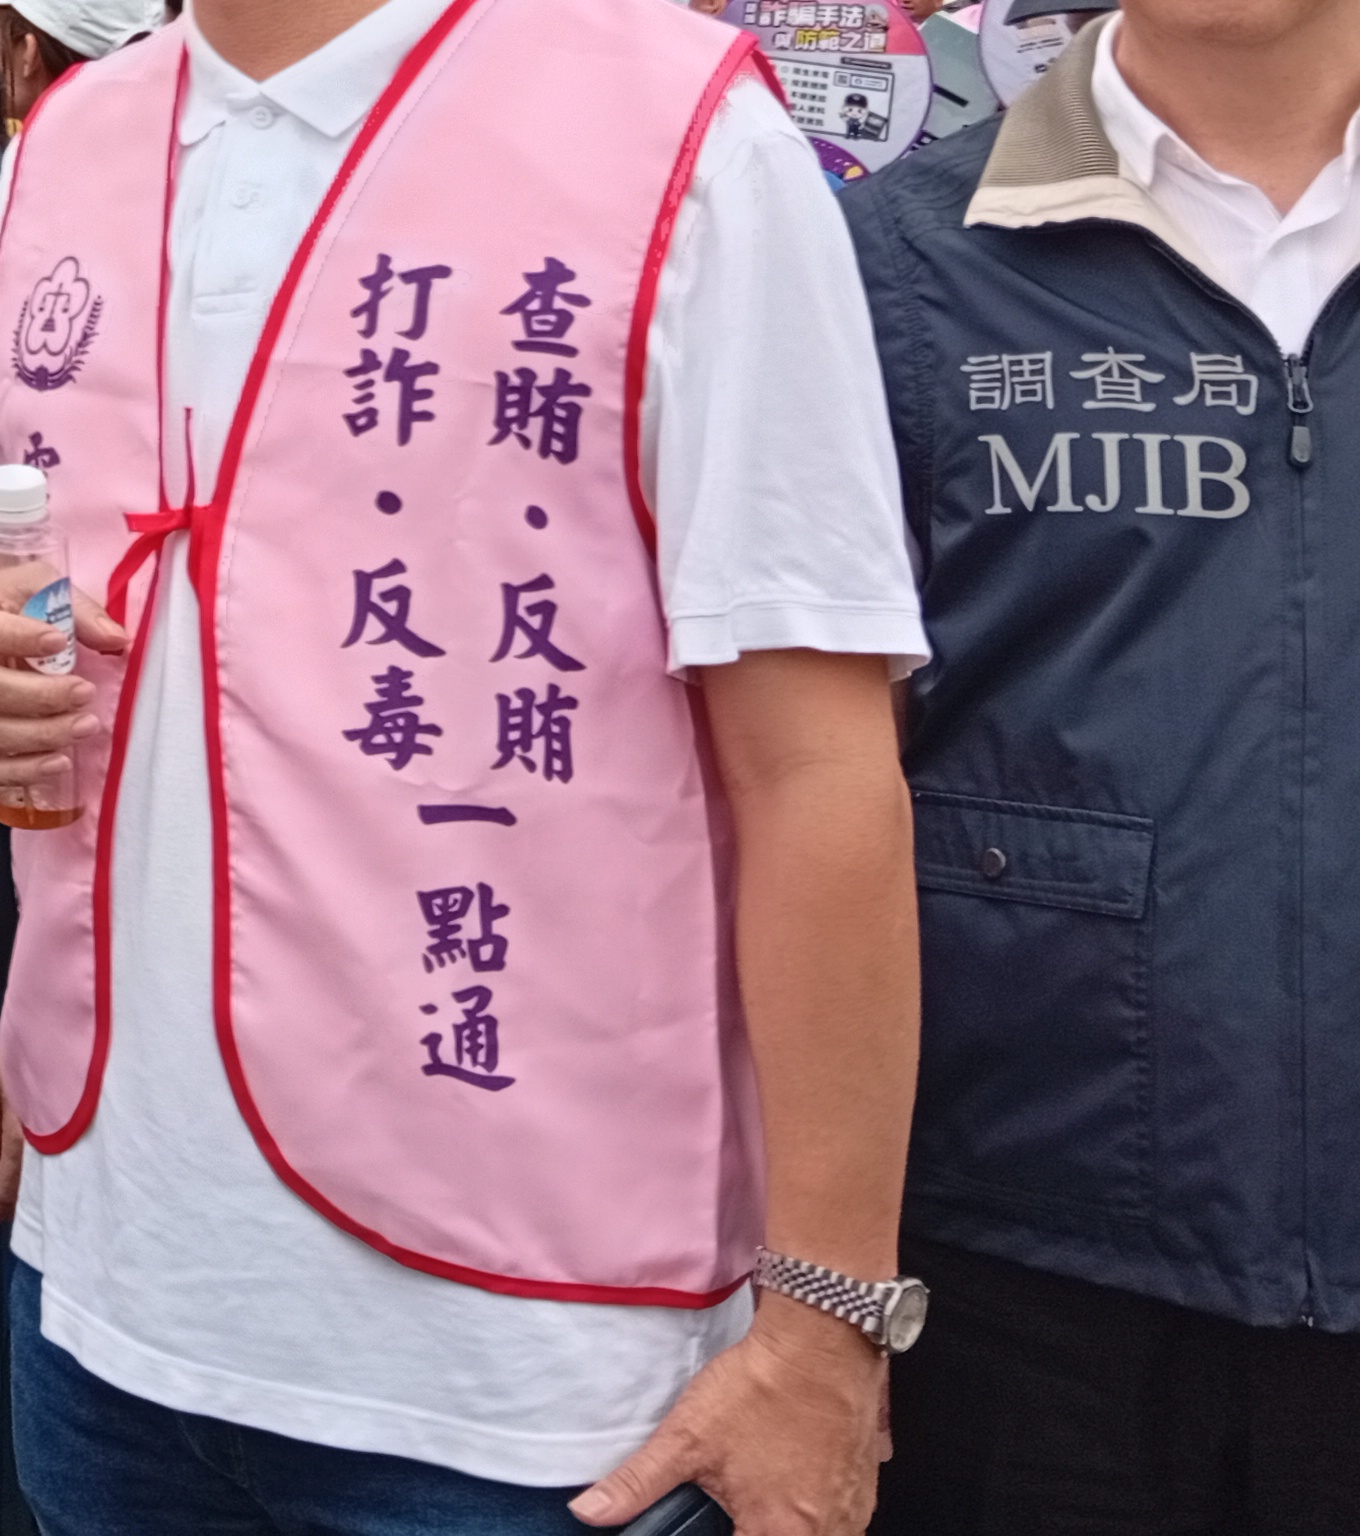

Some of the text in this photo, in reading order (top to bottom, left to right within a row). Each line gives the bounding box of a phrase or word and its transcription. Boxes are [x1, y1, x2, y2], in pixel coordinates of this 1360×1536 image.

[960, 346, 1259, 415] 調查局
[978, 432, 1251, 519] MJIB
[416, 804, 518, 1092] 一點通
